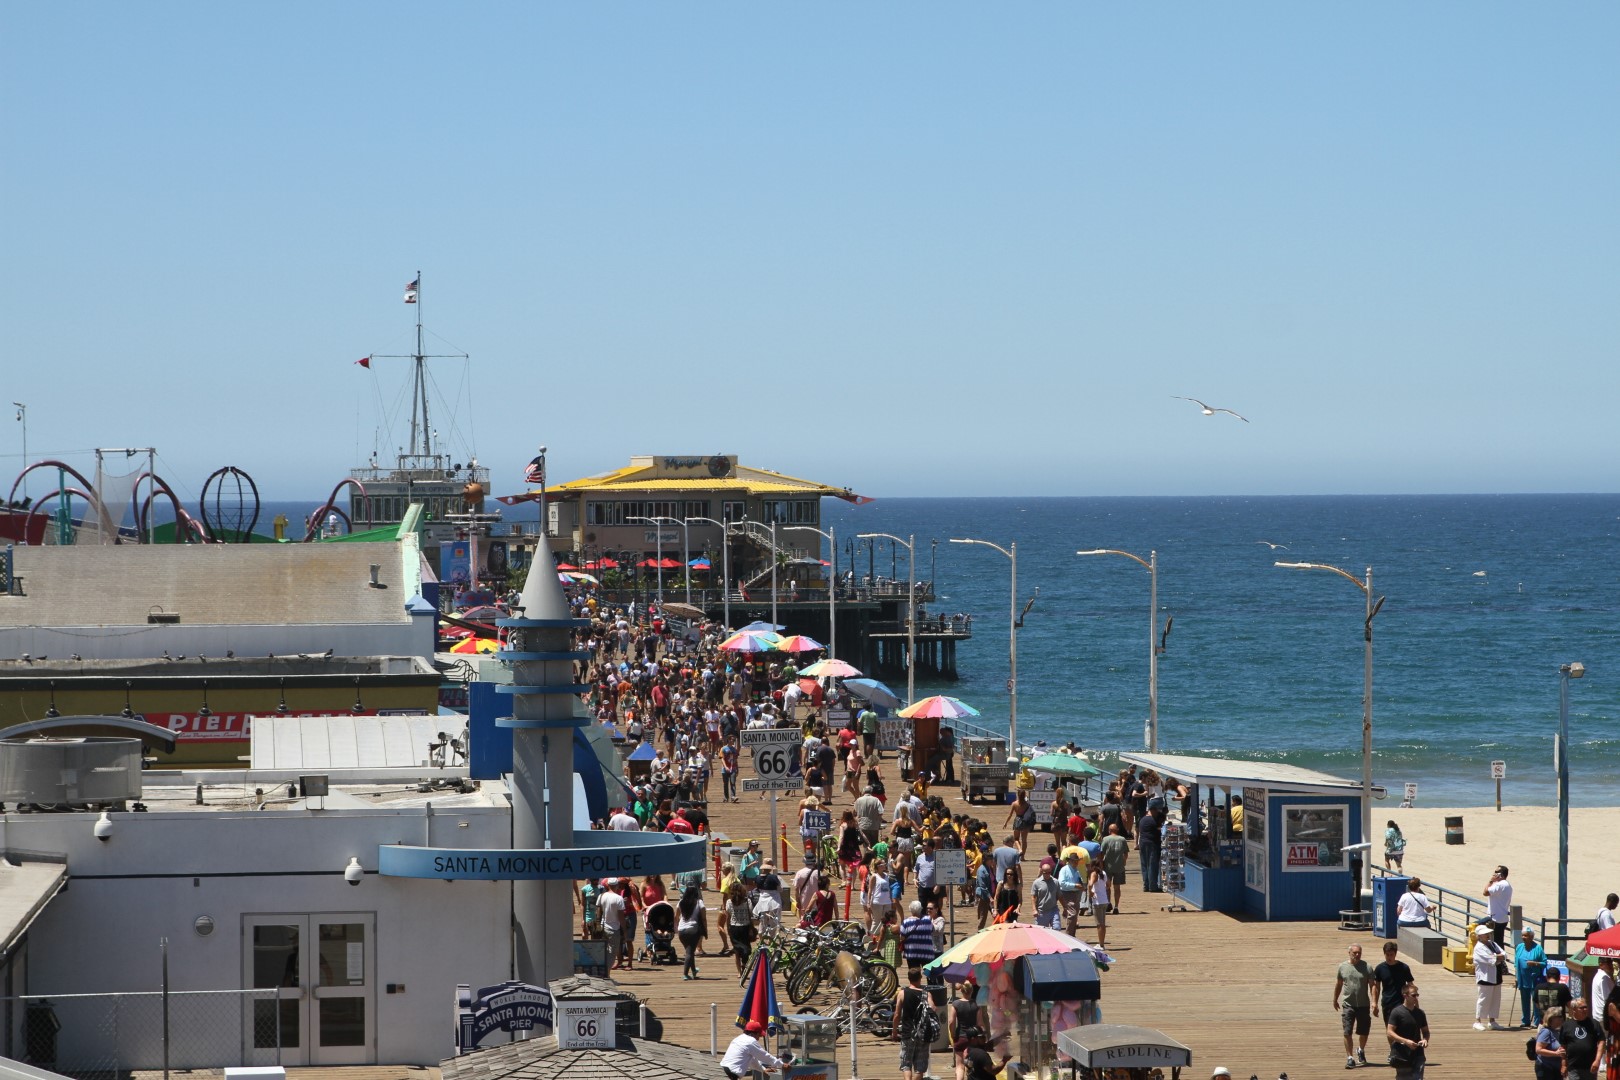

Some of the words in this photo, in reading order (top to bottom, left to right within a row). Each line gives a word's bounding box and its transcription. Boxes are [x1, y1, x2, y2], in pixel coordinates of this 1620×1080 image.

[743, 733, 767, 743] SANTA
[769, 732, 800, 742] MONICA
[759, 750, 786, 775] 66
[745, 781, 760, 790] End
[761, 781, 770, 789] of
[771, 780, 784, 788] the
[784, 780, 801, 788] Trail
[1288, 846, 1318, 859] ATM
[434, 856, 491, 873] SANTA
[498, 856, 574, 873] MONICA
[580, 854, 642, 872] POLICE
[493, 995, 516, 1006] WORLD
[520, 995, 545, 1003] FAMOUS
[566, 1007, 585, 1015] SANTA
[585, 1006, 608, 1015] MONICA
[480, 1008, 514, 1031] SANTA
[509, 1019, 532, 1030] PIER
[577, 1020, 597, 1037] 66
[1106, 1046, 1173, 1060] REDLINE
